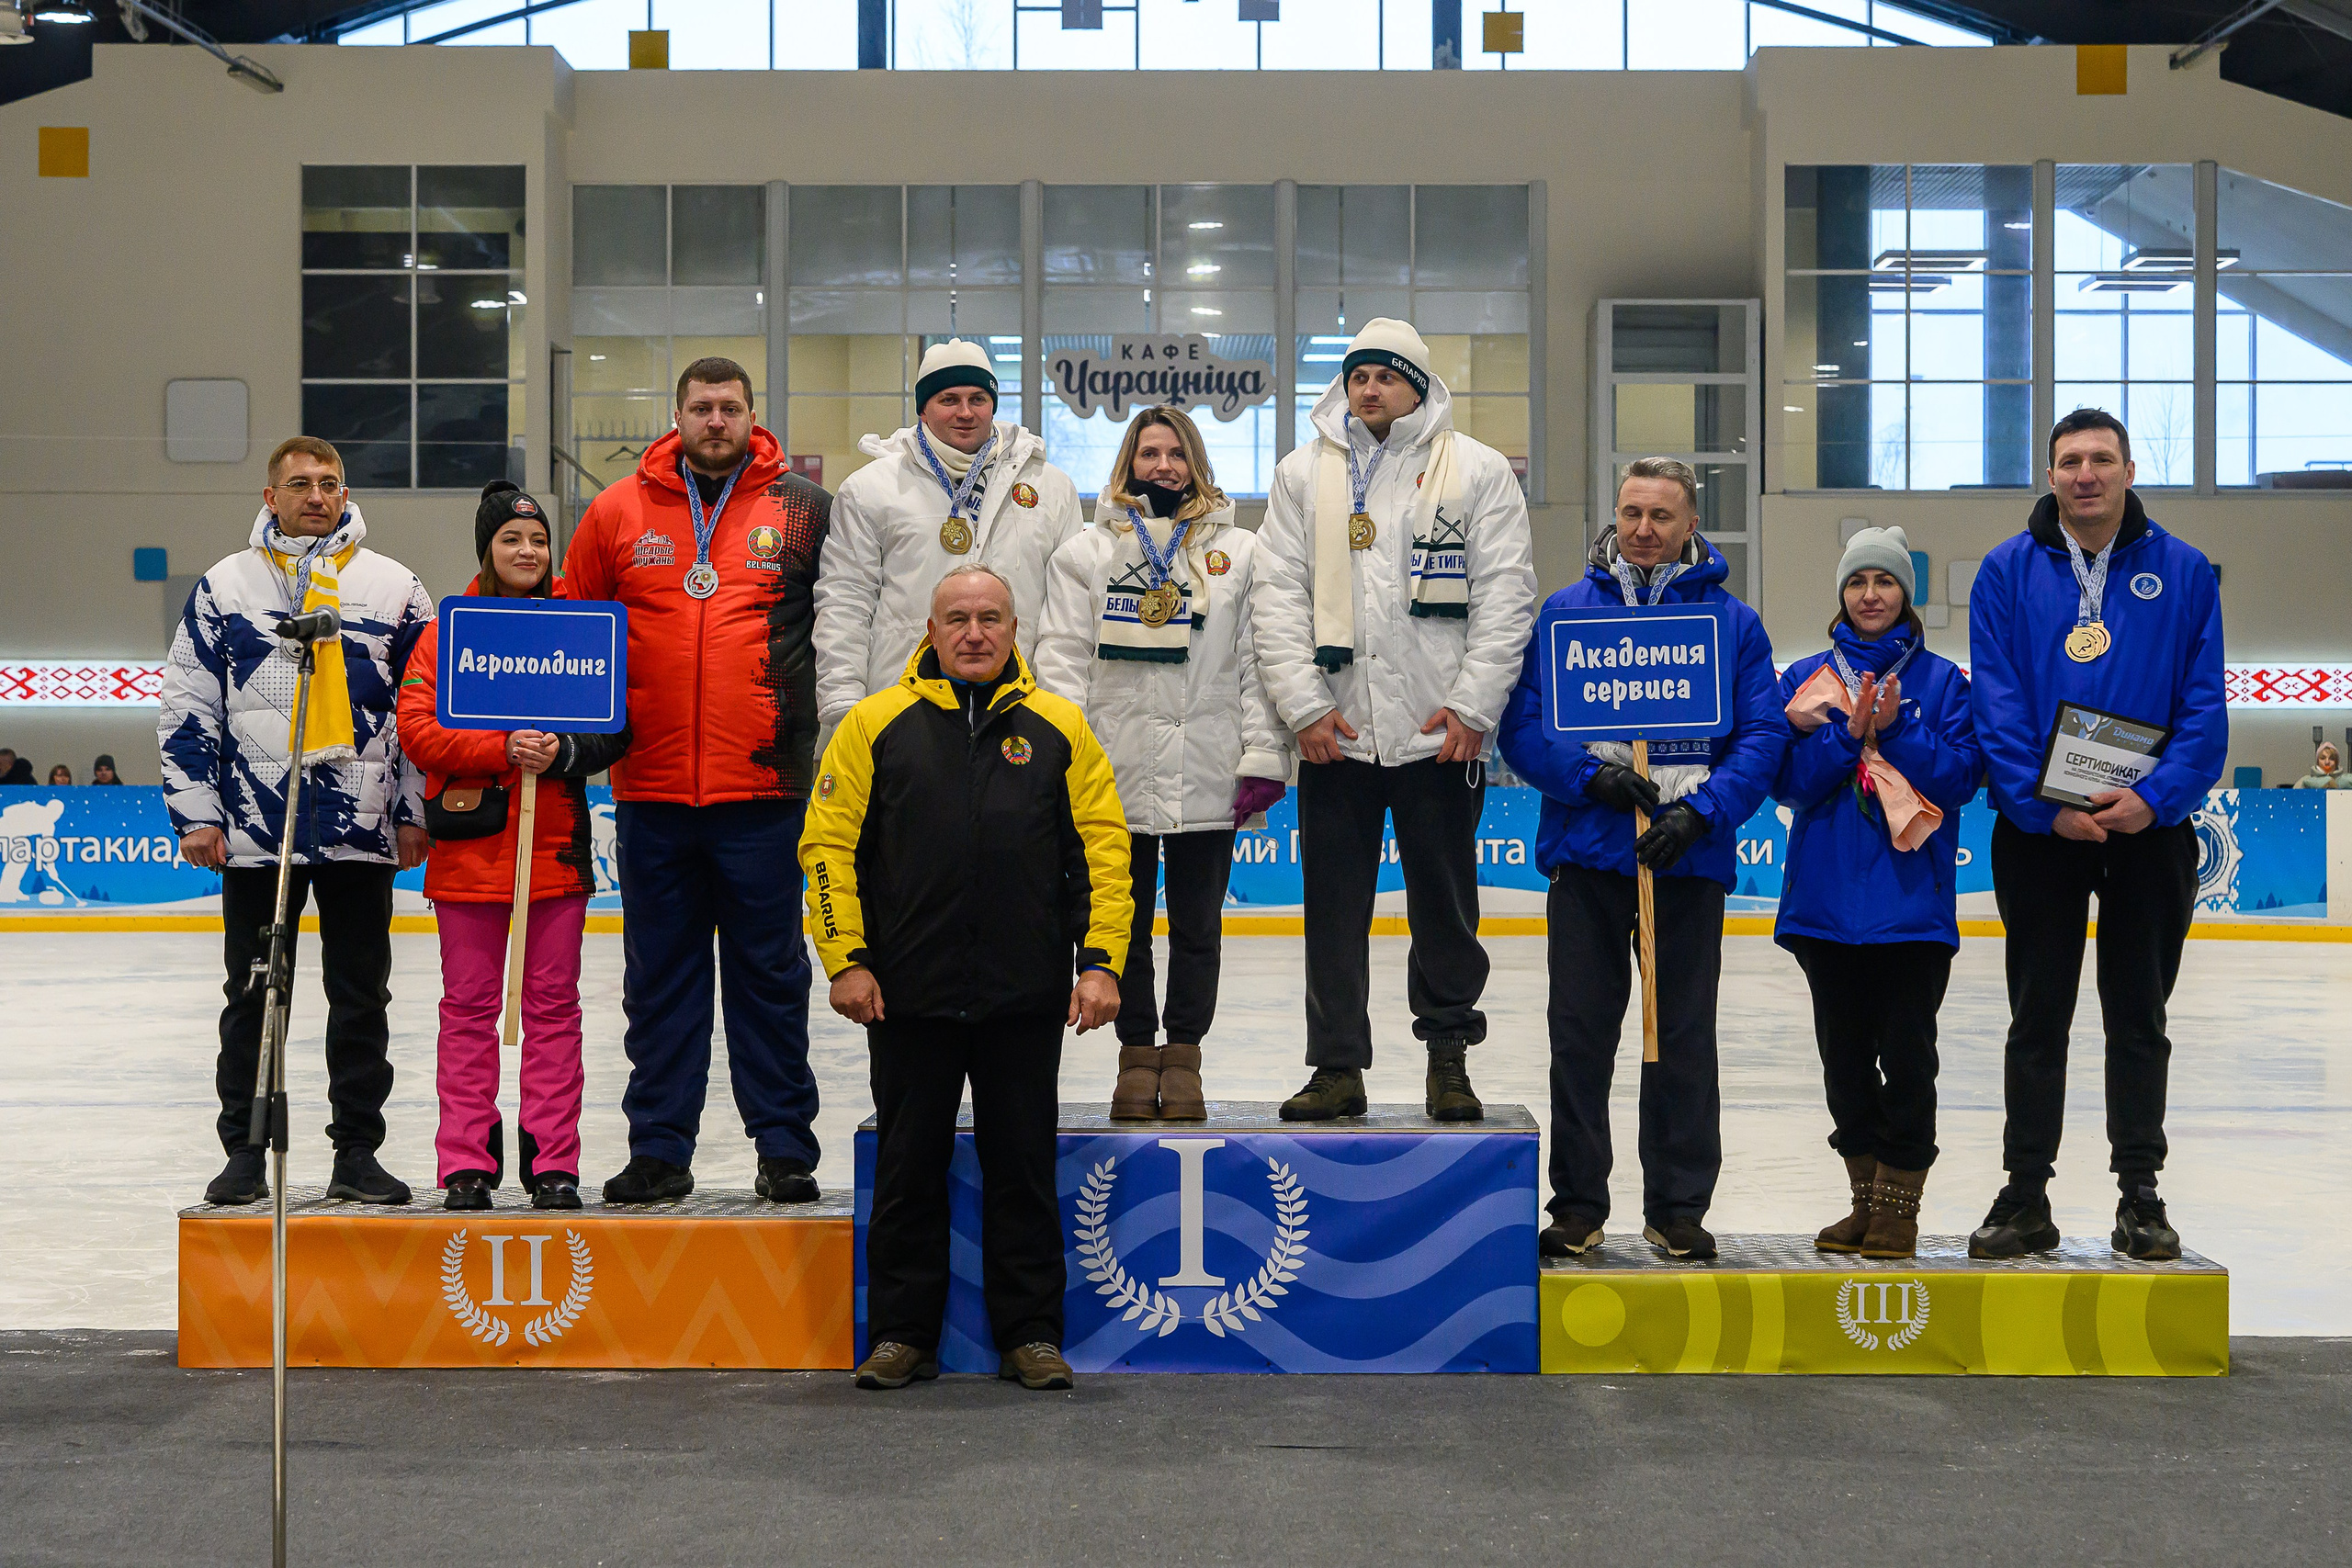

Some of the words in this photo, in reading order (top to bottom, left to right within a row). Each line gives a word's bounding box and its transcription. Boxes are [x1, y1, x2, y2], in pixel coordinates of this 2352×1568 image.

[1122, 344, 1199, 360] КАФЕ
[1056, 359, 1265, 412] Чараўніца
[1392, 357, 1427, 389] БЕЛАРУСЬ
[635, 546, 673, 556] Щедрые
[746, 560, 781, 571] BELARUS
[1438, 555, 1465, 569] ТИГР
[1107, 597, 1140, 614] БЕЛЫ
[458, 648, 606, 680] Агрохолдинг
[1566, 637, 1705, 671] Академия
[1583, 679, 1690, 710] сервиса
[2065, 752, 2141, 781] СЕРТИФИКАТ
[815, 861, 839, 939] BELARUS
[1159, 1139, 1225, 1286] I
[481, 1235, 552, 1305] II
[1852, 1283, 1914, 1323] III
